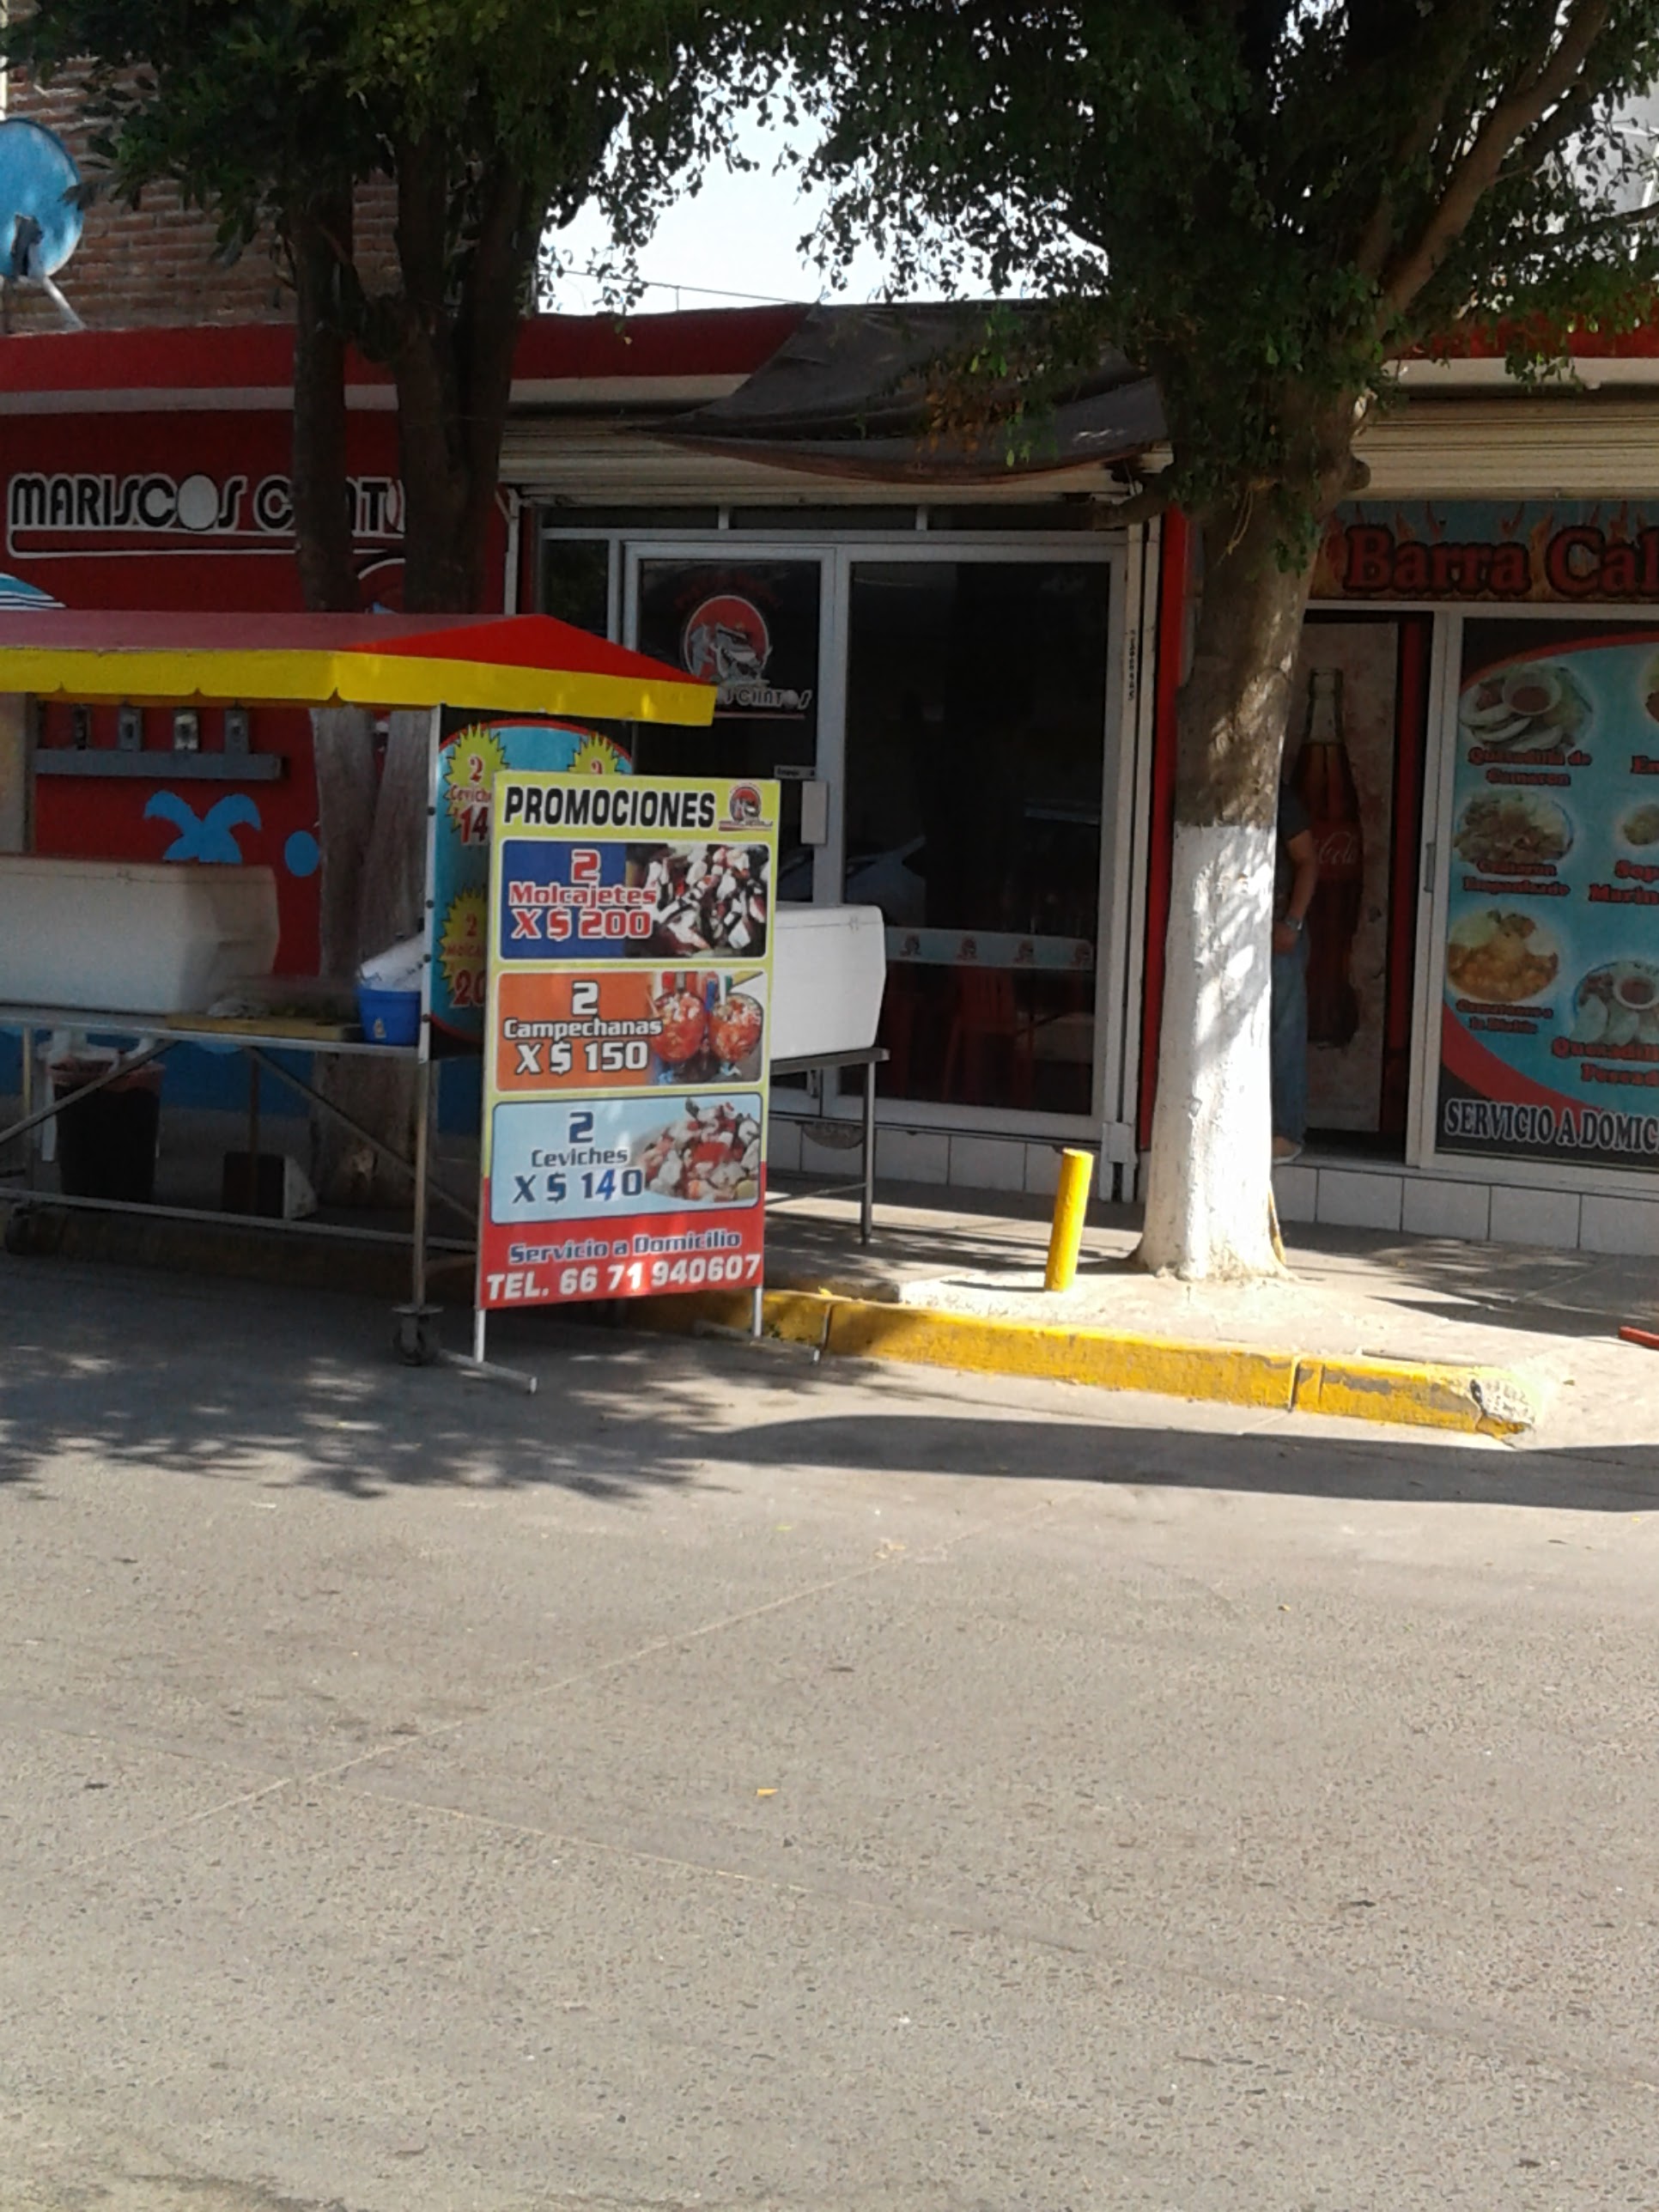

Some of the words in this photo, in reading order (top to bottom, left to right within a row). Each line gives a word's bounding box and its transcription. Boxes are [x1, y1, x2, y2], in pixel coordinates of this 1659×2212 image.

[10, 473, 247, 531] MARISCOS
[1343, 522, 1532, 596] Barra
[504, 786, 715, 828] PROMOCIONES
[572, 848, 599, 883] 2
[508, 882, 657, 910] Molcajetes
[512, 909, 541, 939] X
[572, 981, 599, 1015] 2
[503, 1018, 664, 1040] Campechanas
[515, 1044, 543, 1075] X
[568, 1111, 594, 1144] 2
[1444, 1097, 1556, 1144] SERVICIO
[1555, 1106, 1578, 1147] A
[532, 1146, 628, 1168] Ceviches
[512, 1175, 537, 1204] X
[509, 1239, 608, 1265] Servicio
[612, 1241, 629, 1256] a
[633, 1229, 742, 1255] Domicilio
[486, 1271, 550, 1300] TEL.
[559, 1267, 598, 1295] 66
[606, 1262, 644, 1291] 71
[651, 1253, 762, 1285] 940607
